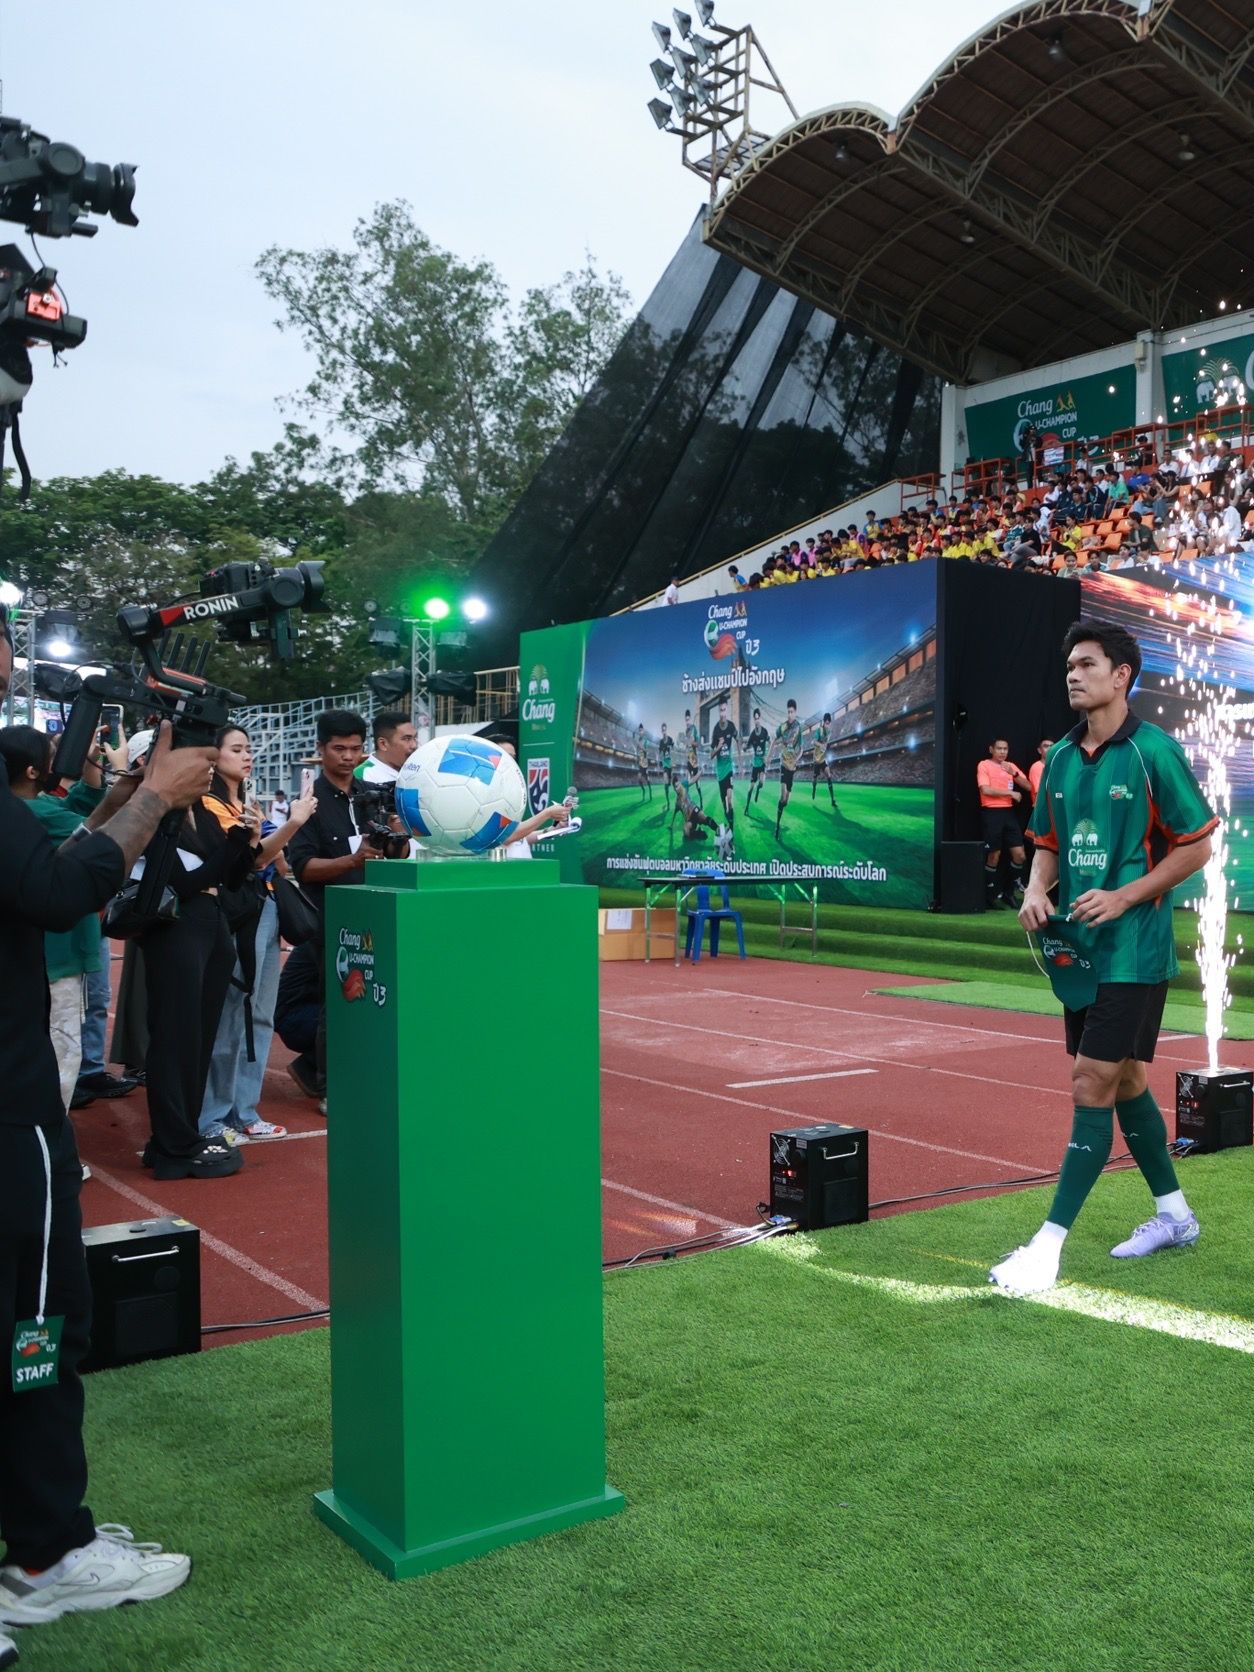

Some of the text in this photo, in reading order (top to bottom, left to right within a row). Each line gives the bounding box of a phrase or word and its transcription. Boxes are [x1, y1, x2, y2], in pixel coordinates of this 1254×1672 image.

[1017, 399, 1053, 418] Chang
[1035, 411, 1077, 430] U-CHAMPION
[1062, 427, 1076, 438] CUP
[183, 596, 239, 620] RONIN
[708, 604, 732, 619] Chang
[718, 618, 748, 631] U-CHAMPION
[736, 630, 746, 640] CUP
[522, 699, 555, 723] Chang
[1068, 848, 1107, 870] Chang
[340, 927, 361, 951] Chang
[1043, 937, 1063, 947] Chang
[349, 953, 374, 966] U-CHAMPION
[364, 969, 373, 980] CUP
[16, 1363, 54, 1384] STAFF
